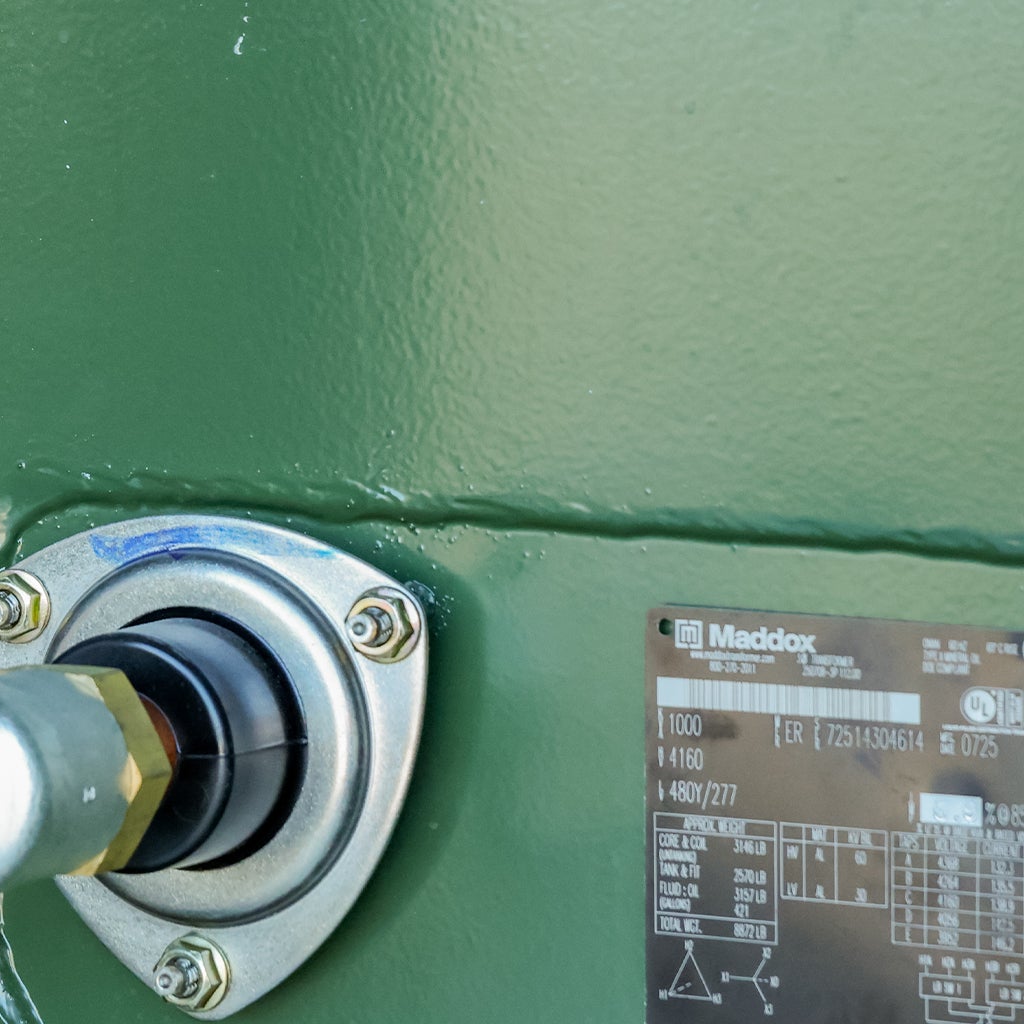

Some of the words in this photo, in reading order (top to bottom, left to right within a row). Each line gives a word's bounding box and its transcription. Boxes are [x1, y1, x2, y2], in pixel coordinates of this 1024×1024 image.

[709, 623, 817, 653] Maddox
[669, 713, 703, 737] 1000
[785, 720, 804, 745] ER
[961, 733, 999, 758] 0725
[669, 746, 704, 771] 4160
[669, 780, 738, 810] 480Y/277
